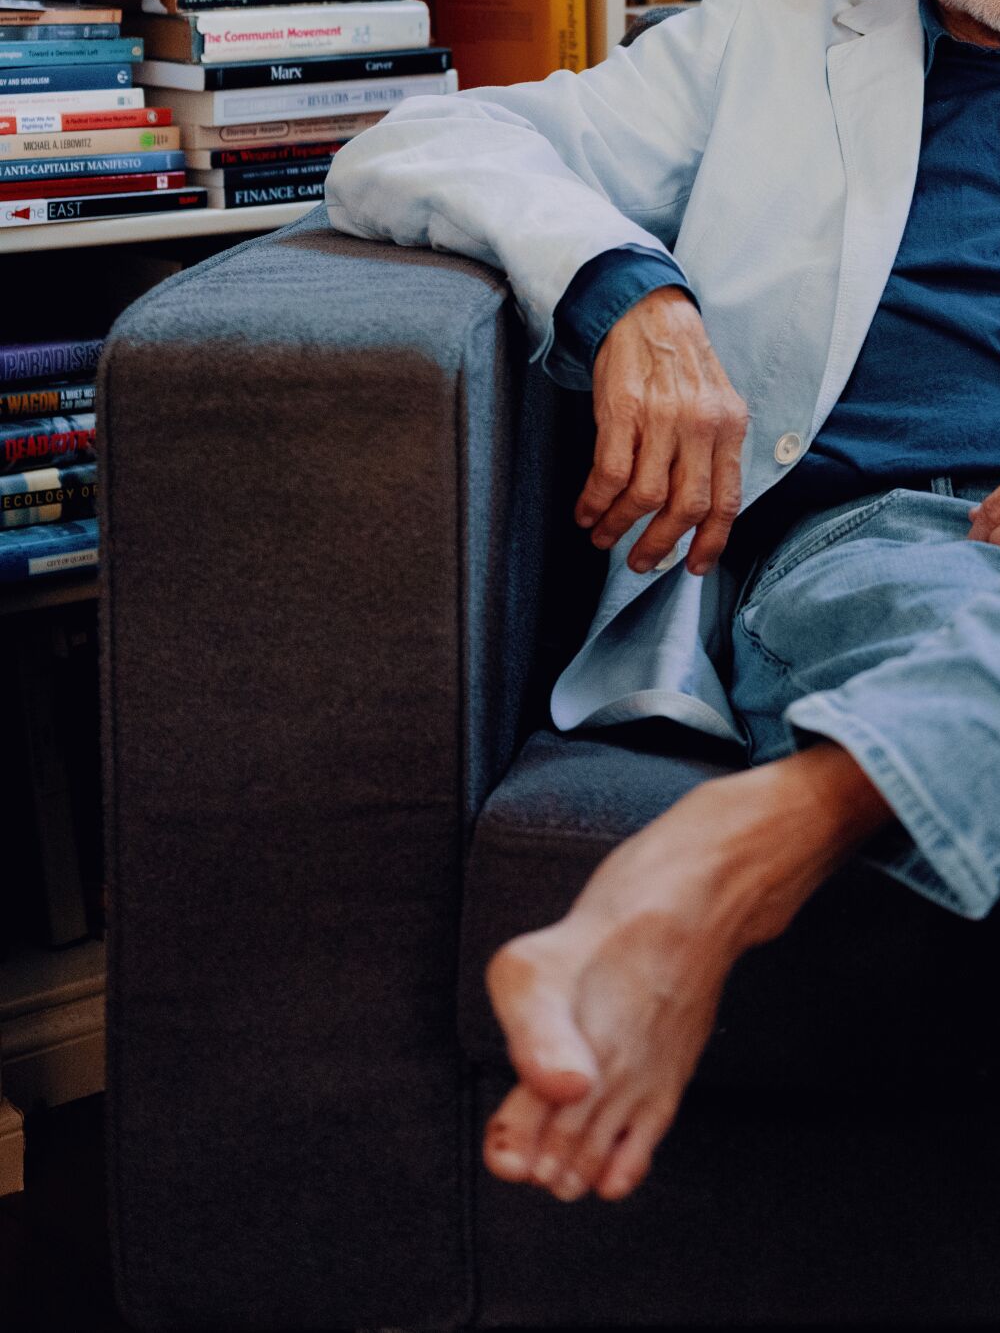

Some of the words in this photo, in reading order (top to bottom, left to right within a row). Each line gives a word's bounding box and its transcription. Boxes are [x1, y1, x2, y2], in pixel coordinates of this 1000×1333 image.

[204, 31, 222, 44] The
[223, 28, 284, 43] Communist
[287, 26, 342, 39] Movement
[270, 64, 303, 80] Marx
[365, 61, 394, 72] Carver
[8, 77, 20, 85] AND
[20, 76, 50, 85] SOCIALISM
[23, 139, 51, 152] MICHAEL
[52, 138, 59, 150] A.
[60, 137, 92, 150] LEBOWITZ
[4, 158, 89, 177] ANTI-CAPITALIST
[90, 157, 142, 171] MANIFESTO
[235, 185, 295, 205] FINANCE
[49, 201, 83, 218] EAST
[8, 391, 58, 412] WAGON
[5, 434, 50, 462] DEAD
[4, 488, 74, 508] ECOLOGY
